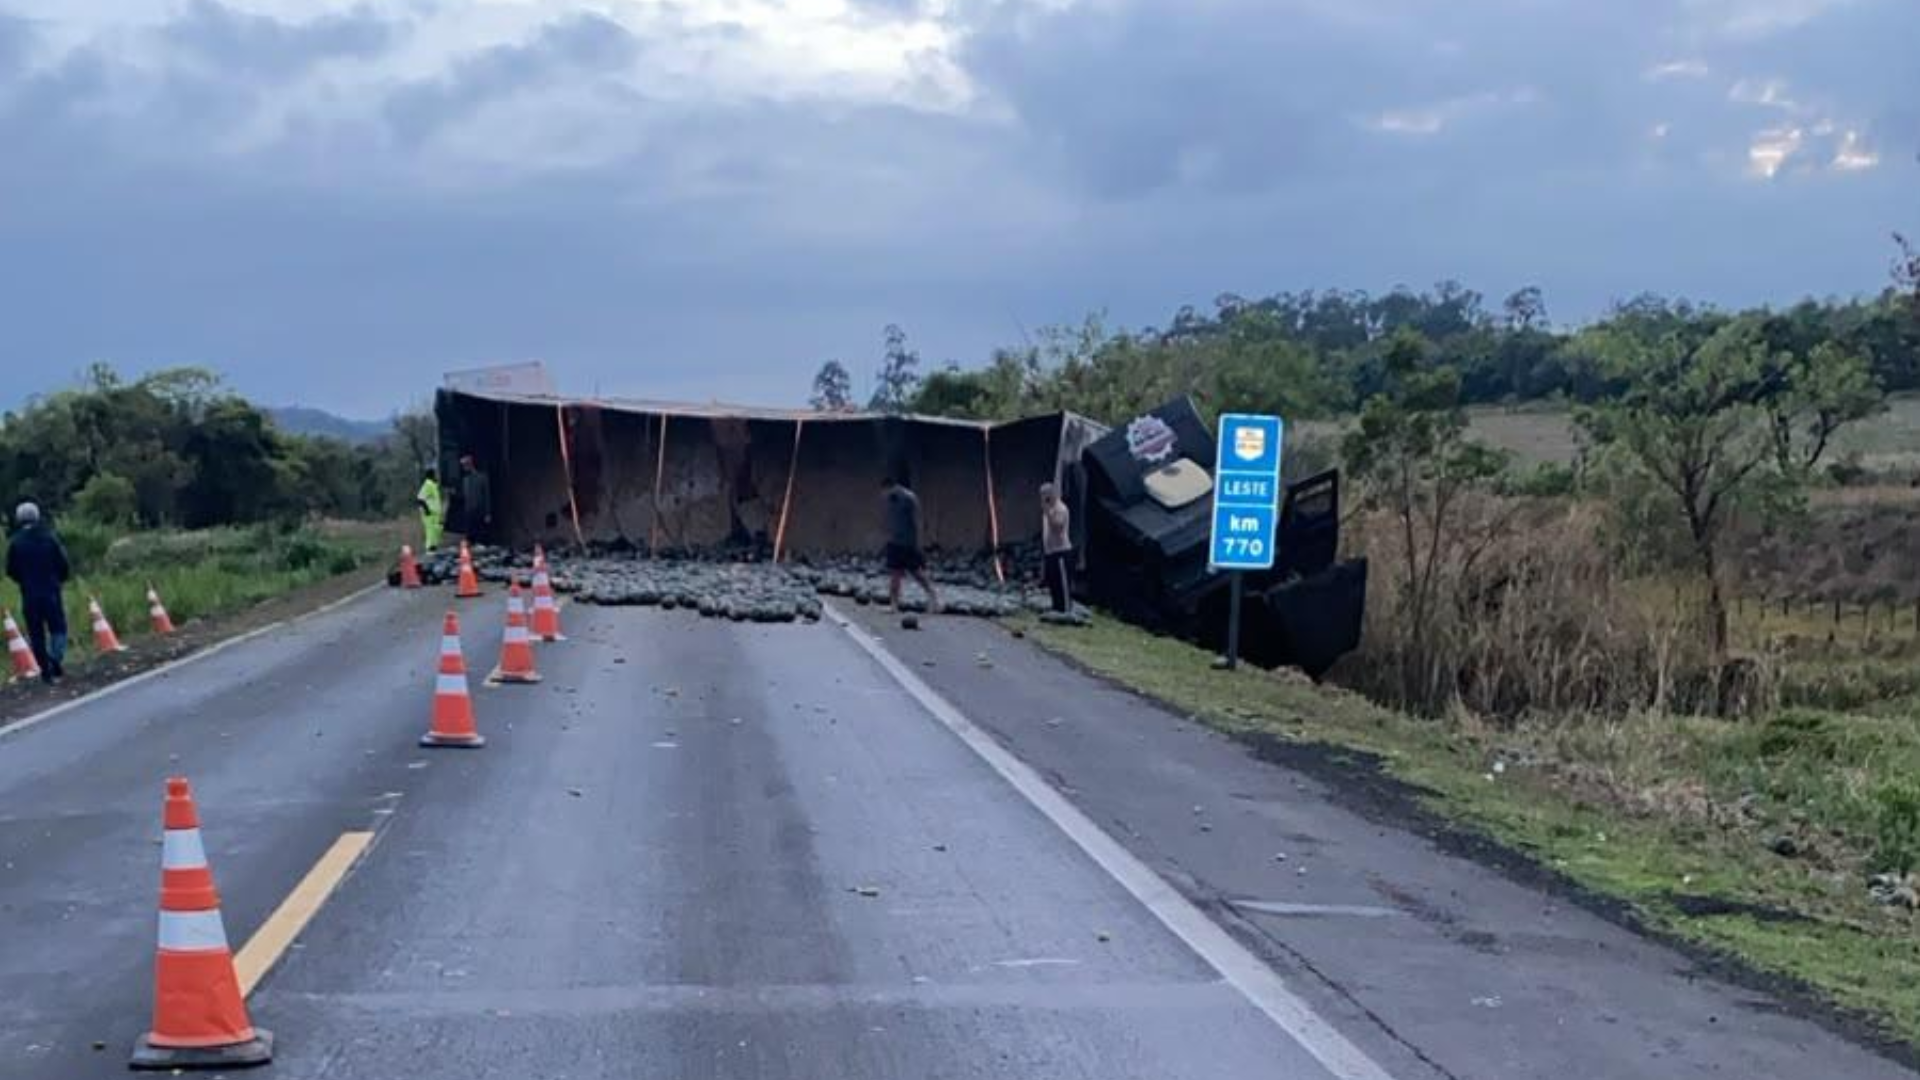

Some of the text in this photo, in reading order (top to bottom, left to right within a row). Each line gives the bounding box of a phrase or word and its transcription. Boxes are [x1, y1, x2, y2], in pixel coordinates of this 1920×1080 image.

[1224, 481, 1268, 496] LESTE
[1230, 514, 1259, 532] km
[1223, 538, 1263, 556] 770
